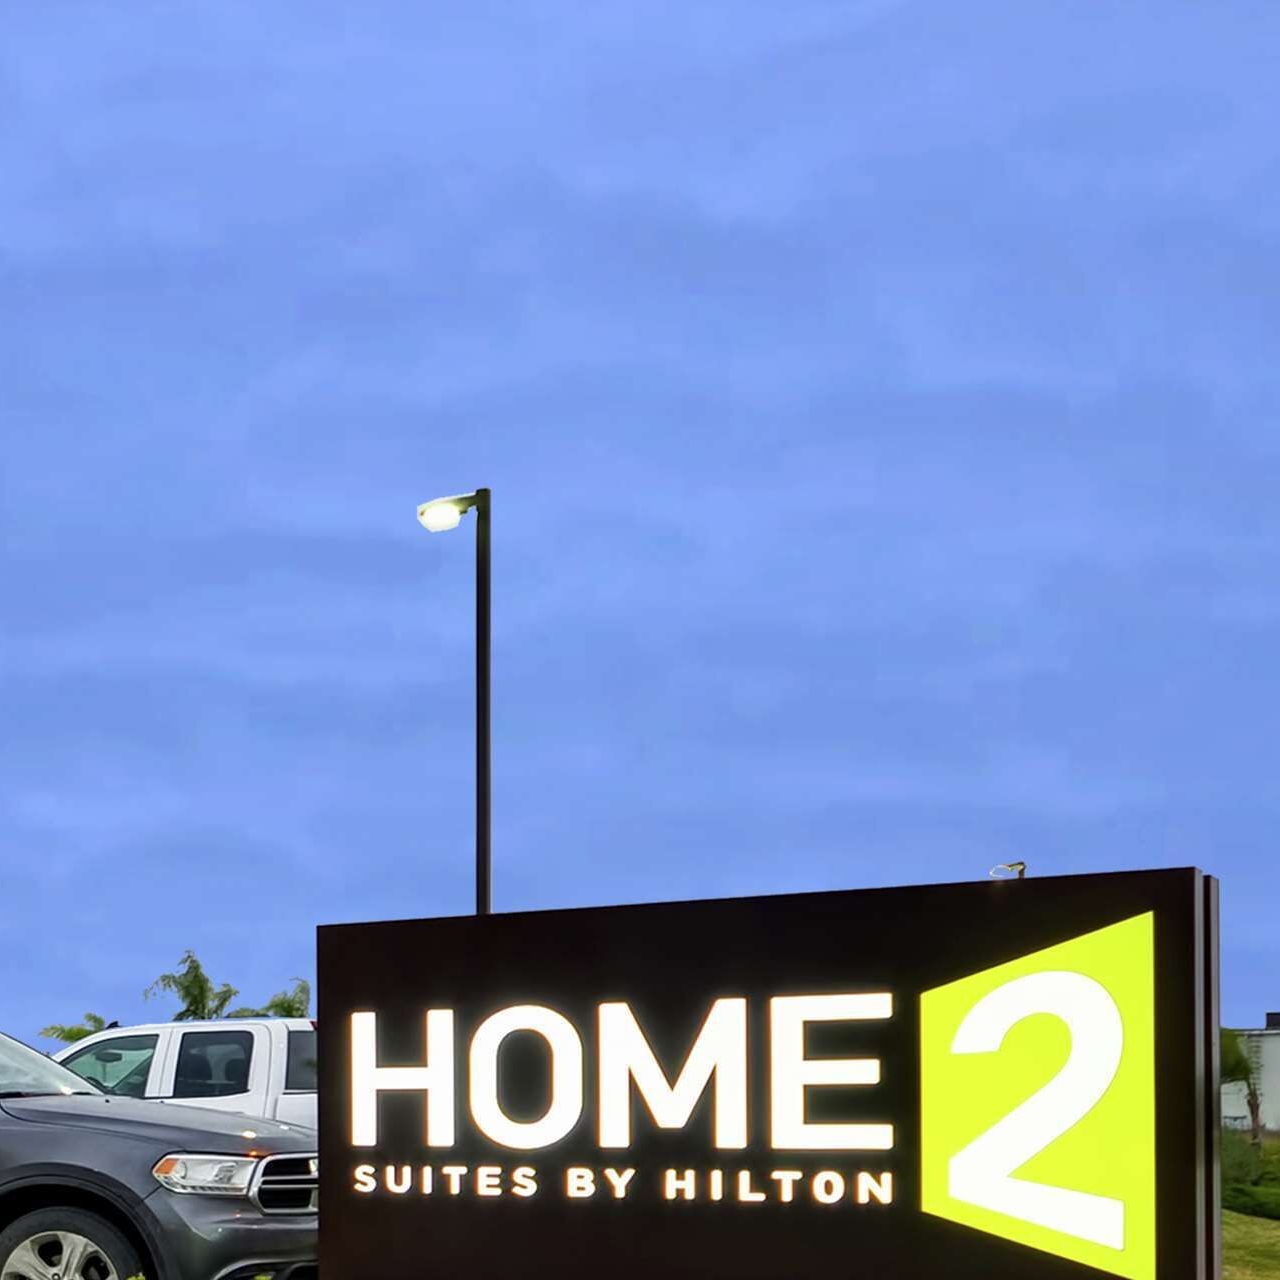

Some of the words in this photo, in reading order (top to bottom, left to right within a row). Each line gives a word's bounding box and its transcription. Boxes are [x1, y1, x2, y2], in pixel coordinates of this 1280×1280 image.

[352, 993, 893, 1149] HOME
[949, 971, 1126, 1251] 2
[353, 1165, 538, 1198] SUITES
[567, 1167, 636, 1199] BY
[665, 1169, 893, 1204] HILTON
